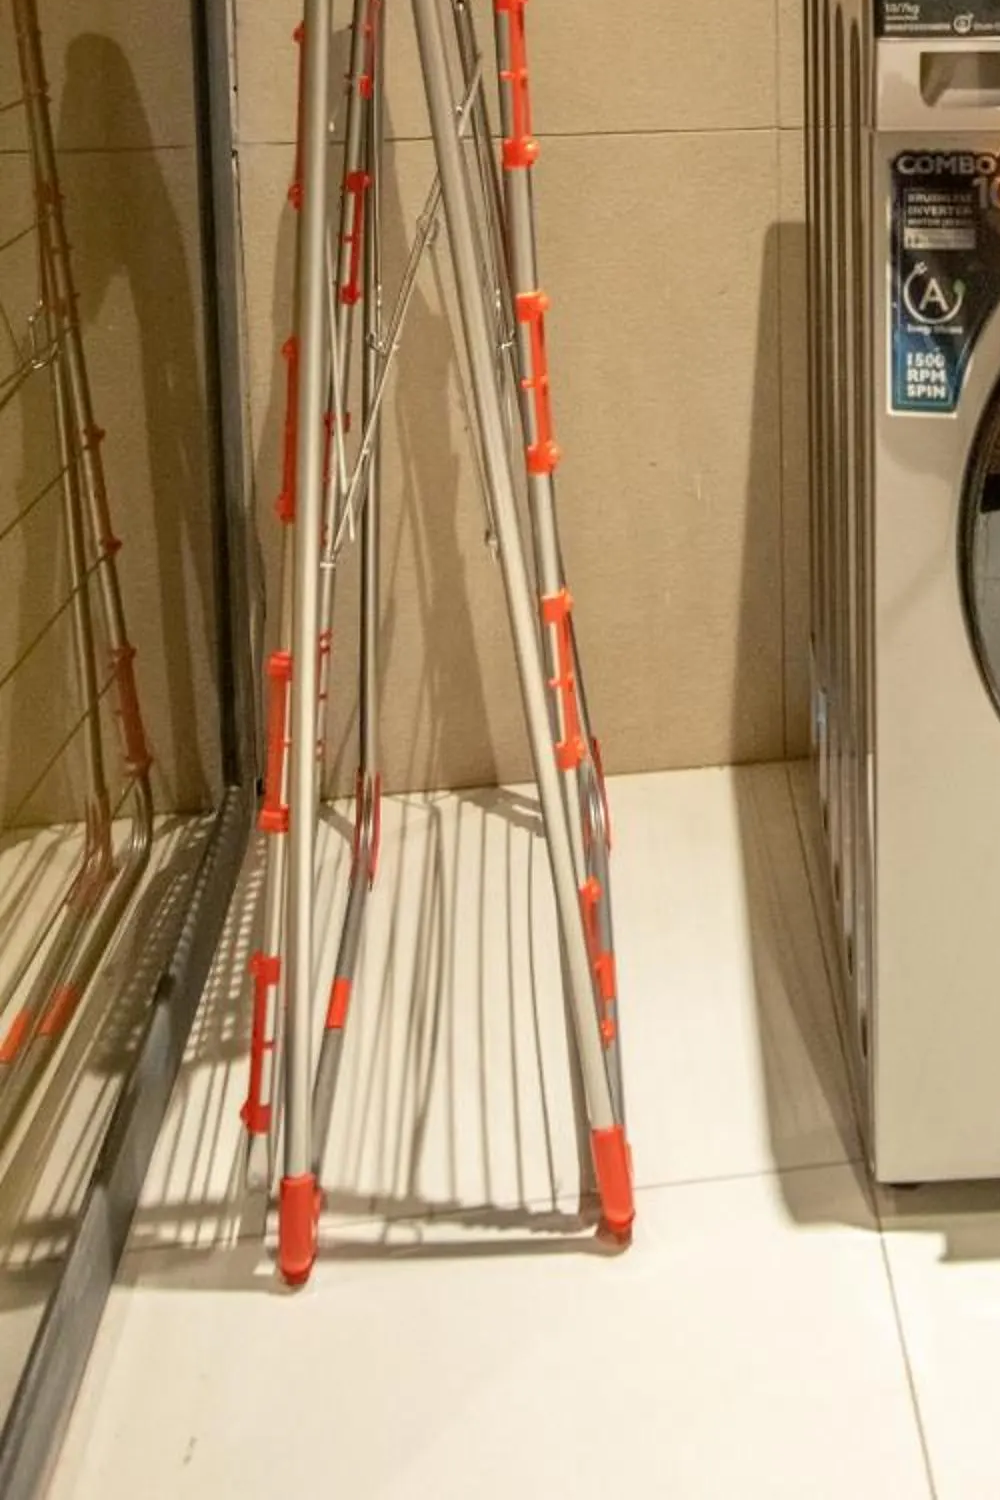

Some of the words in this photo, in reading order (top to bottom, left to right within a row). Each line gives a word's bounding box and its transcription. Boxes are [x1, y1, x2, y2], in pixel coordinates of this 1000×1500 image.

[897, 155, 998, 175] COMBO
[919, 277, 950, 312] A
[907, 369, 946, 382] RPM
[907, 384, 946, 398] SPIN
